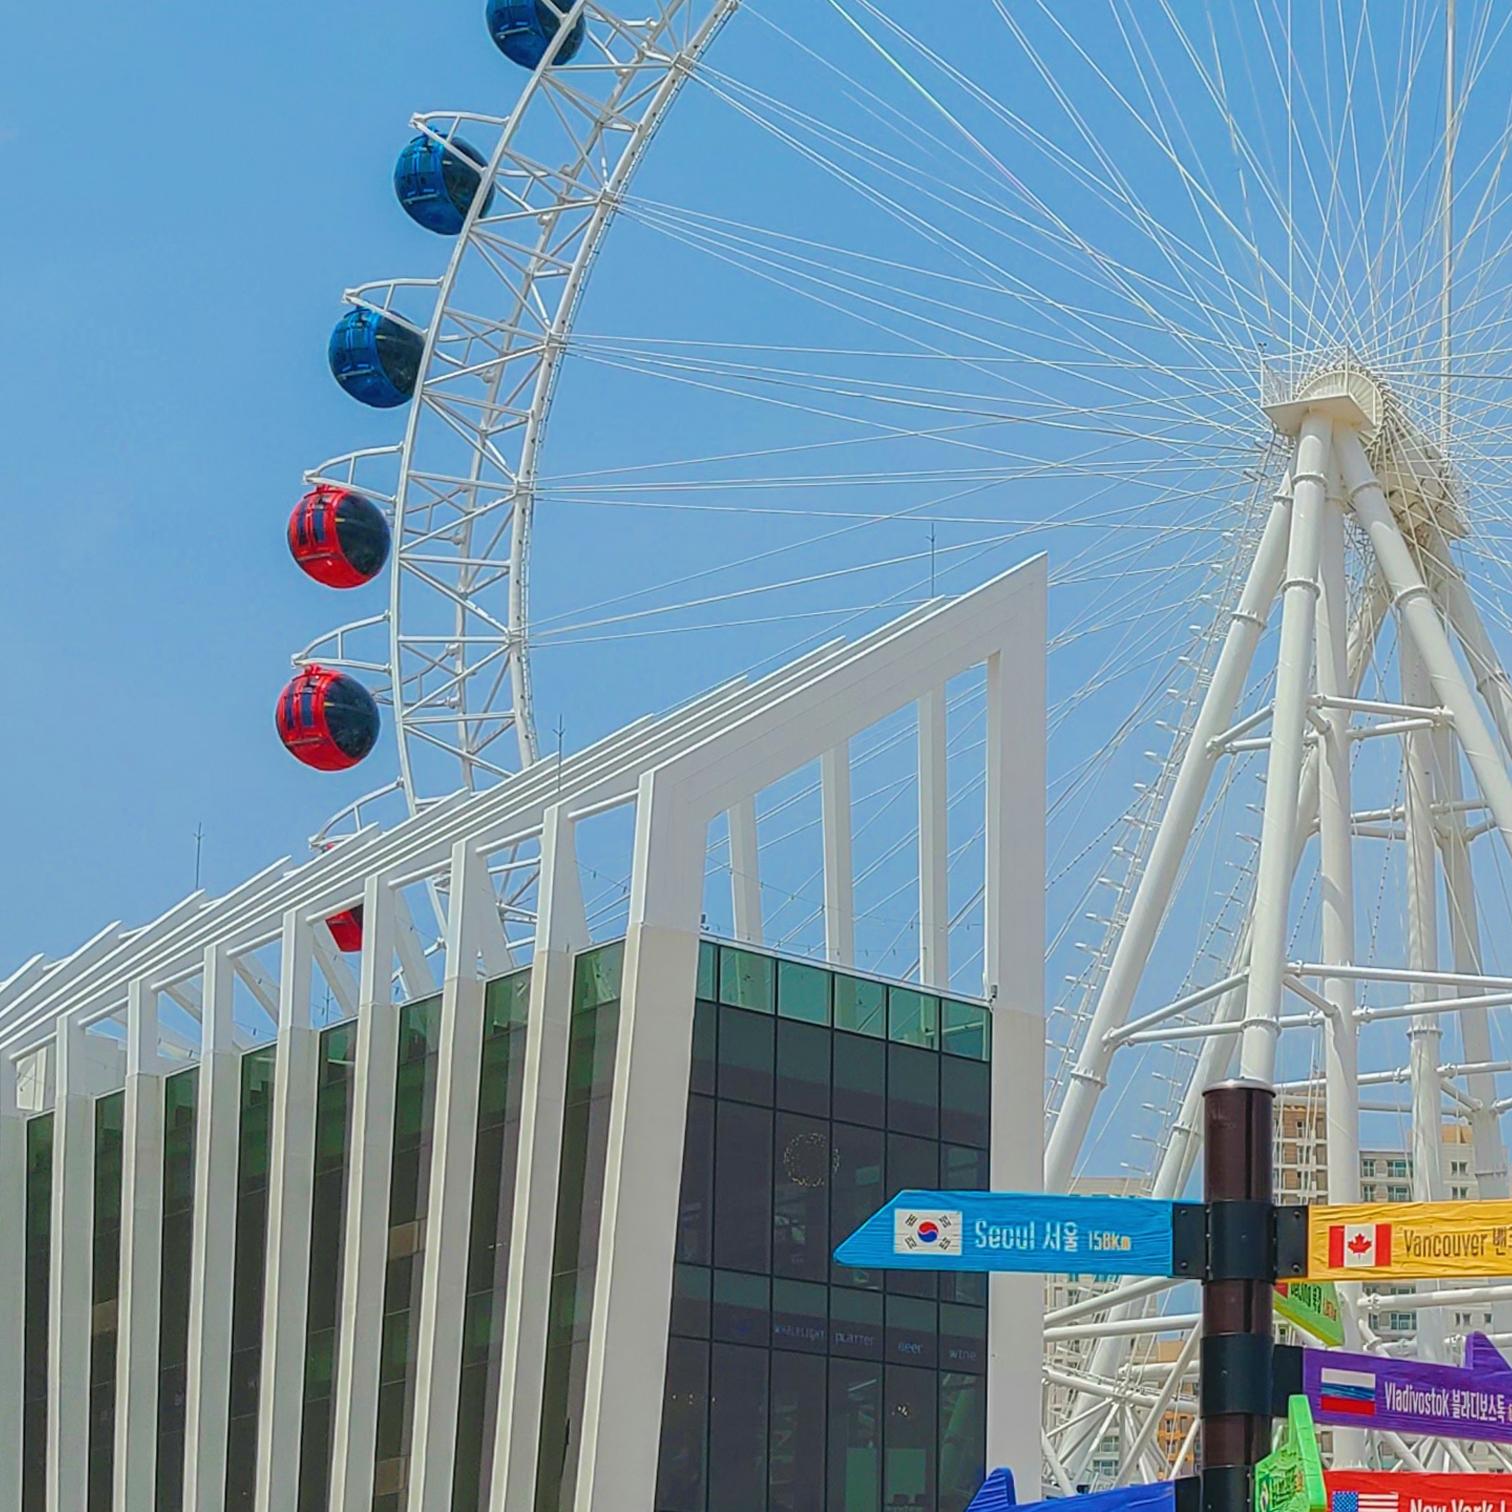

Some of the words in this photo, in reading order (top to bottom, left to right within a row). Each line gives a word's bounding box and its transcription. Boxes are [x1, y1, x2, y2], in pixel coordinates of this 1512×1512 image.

[975, 1219, 1035, 1250] Seoul
[1043, 1221, 1079, 1252] 서울
[1403, 1229, 1488, 1258] Vancouver
[1385, 1381, 1450, 1417] Vladivostok
